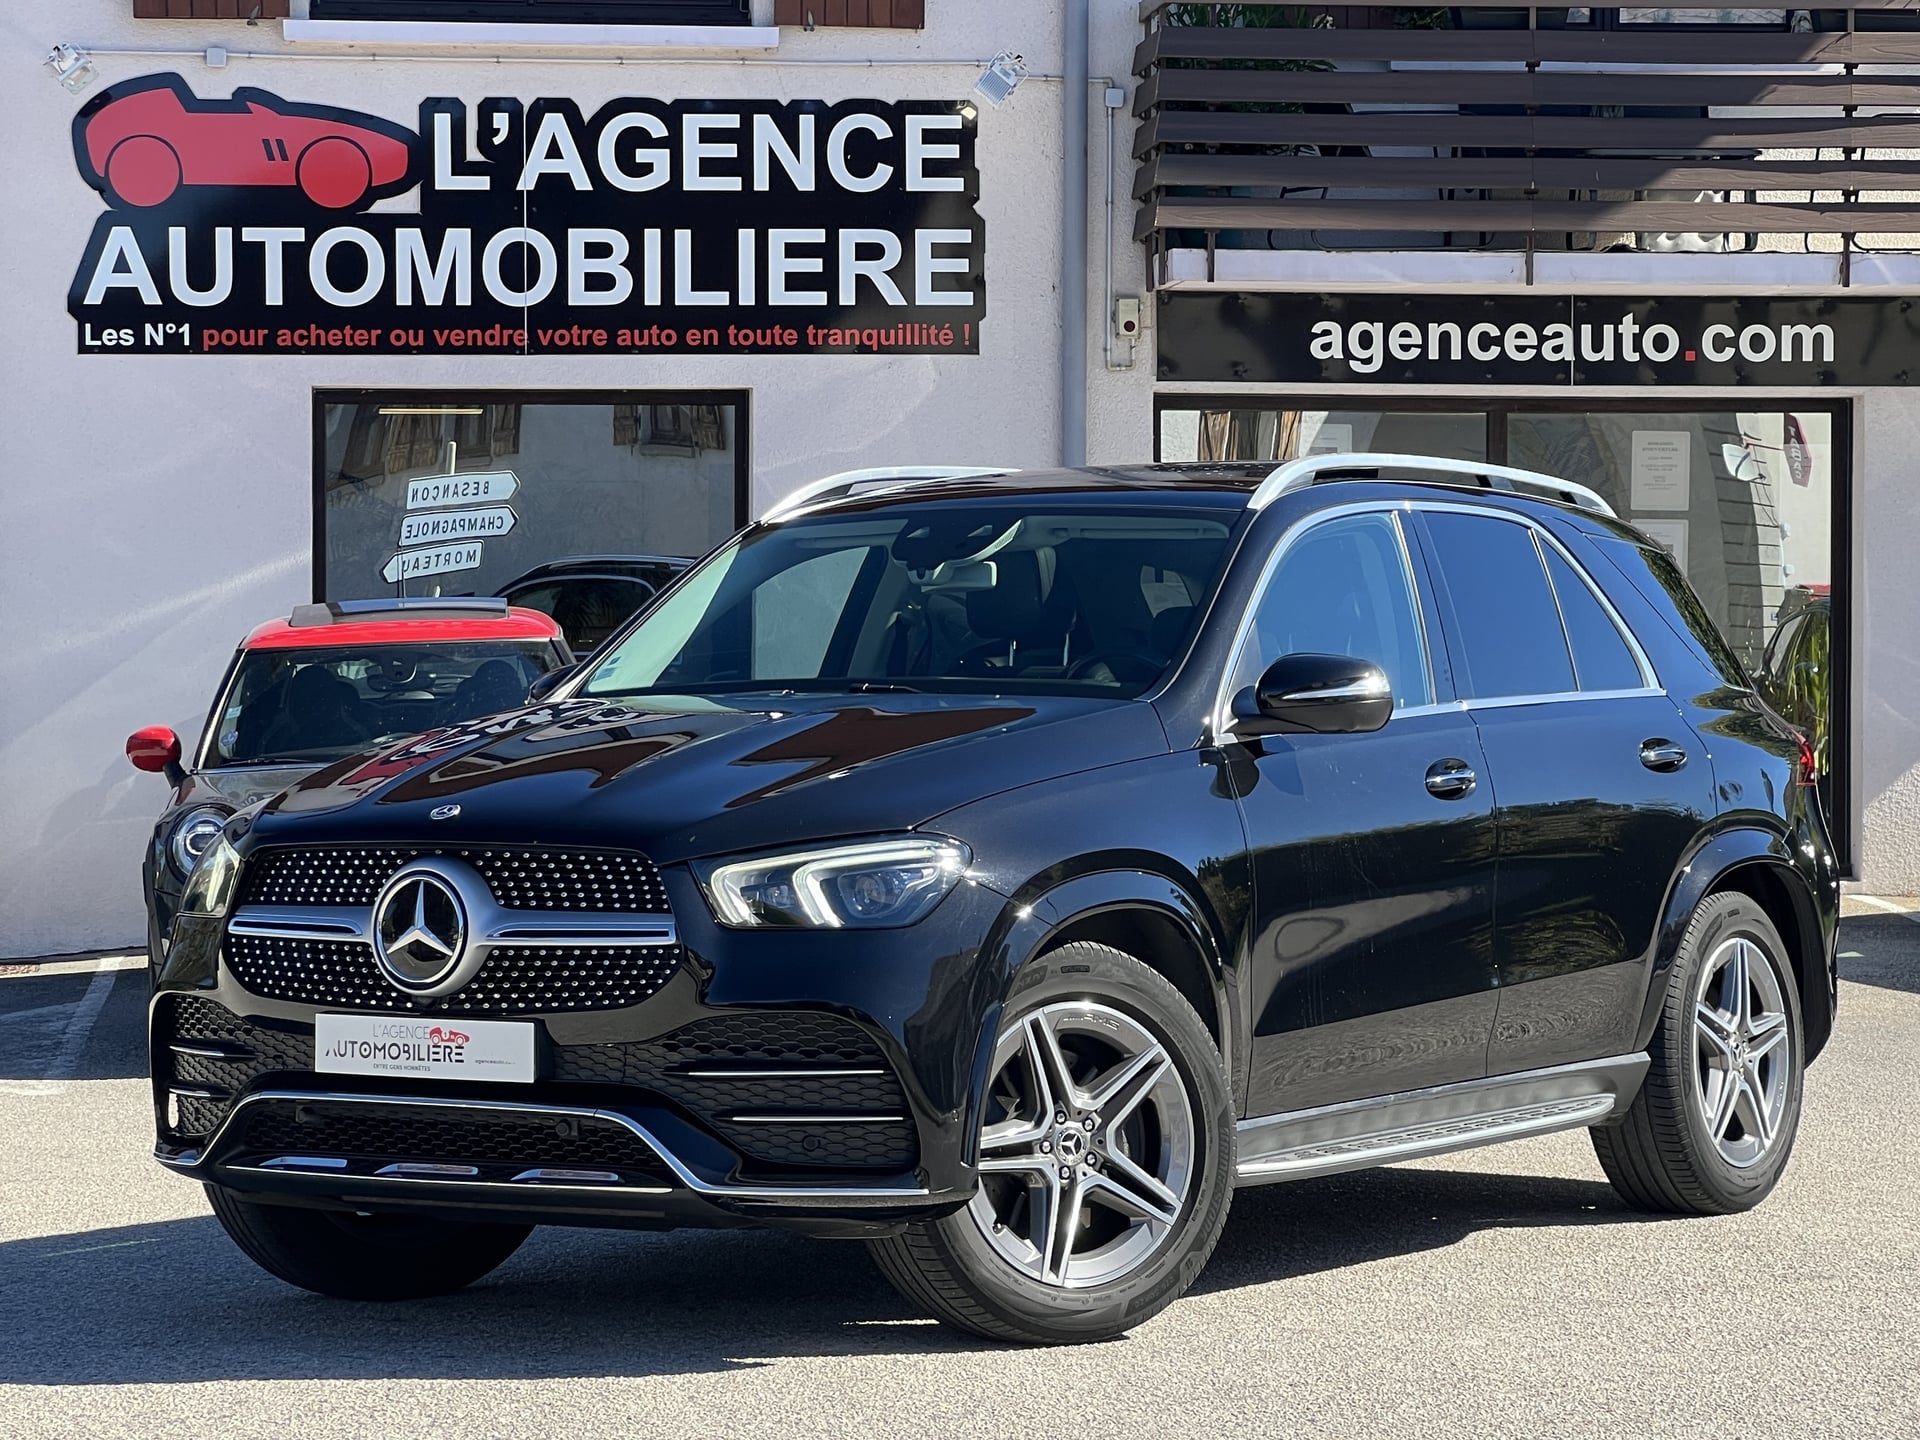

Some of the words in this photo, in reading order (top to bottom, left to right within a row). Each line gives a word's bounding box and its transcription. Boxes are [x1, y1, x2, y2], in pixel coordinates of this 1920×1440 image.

[433, 111, 966, 193] L'AGENCE
[82, 225, 975, 308] AUTOMOBILIERE
[84, 323, 135, 346] Les
[144, 323, 191, 346] N°1
[202, 328, 268, 351] pour
[276, 324, 381, 347] acheter
[389, 329, 425, 347] ou
[433, 324, 528, 347] vendre
[537, 325, 608, 347] votre
[616, 325, 678, 347] auto
[685, 328, 720, 347] en
[727, 324, 799, 347] toute
[806, 323, 955, 351] tranquillité
[1309, 312, 1836, 374] agenceauto.com
